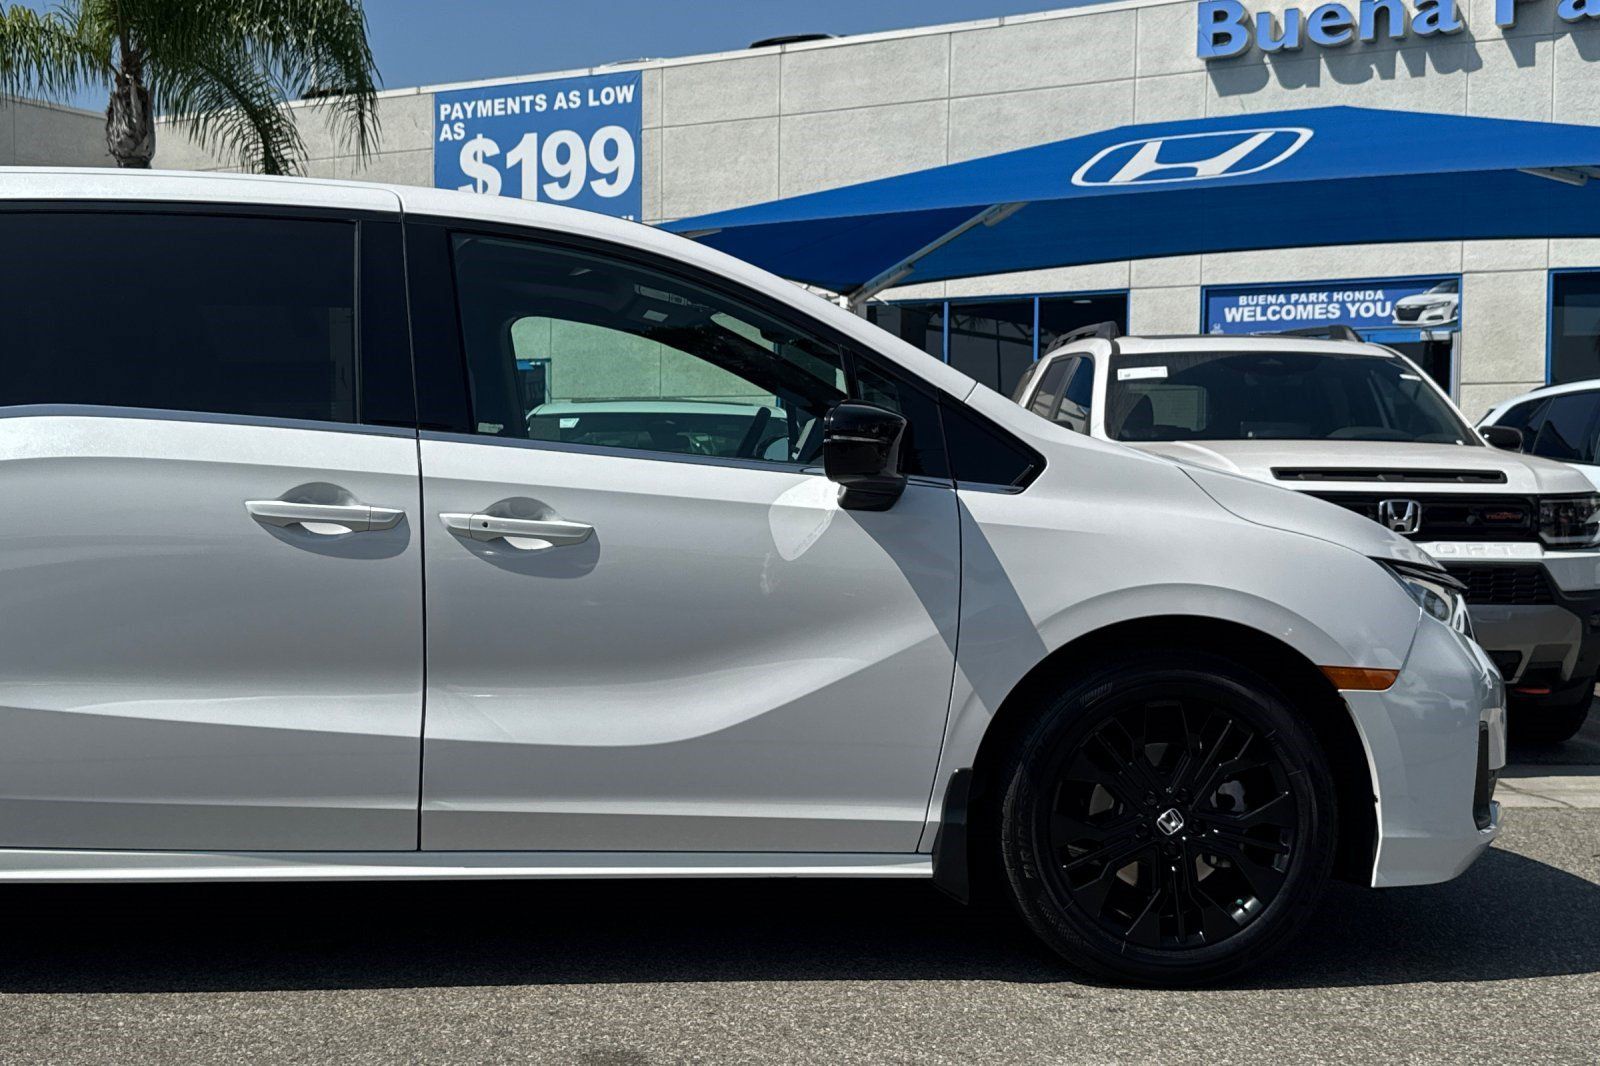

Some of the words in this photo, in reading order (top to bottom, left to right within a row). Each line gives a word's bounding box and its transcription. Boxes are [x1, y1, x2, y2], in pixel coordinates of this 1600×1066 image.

[1197, 0, 1462, 60] Buena
[439, 94, 547, 121] PAYMENTS
[553, 90, 581, 111] AS
[588, 84, 635, 107] LOW
[439, 122, 466, 142] AS
[457, 125, 636, 202] $199
[1224, 304, 1341, 323] WELCOMES
[1346, 301, 1392, 318] YOU
[1238, 294, 1285, 306] BUENA
[1290, 292, 1328, 304] PARK
[1333, 289, 1385, 302] HONDA
